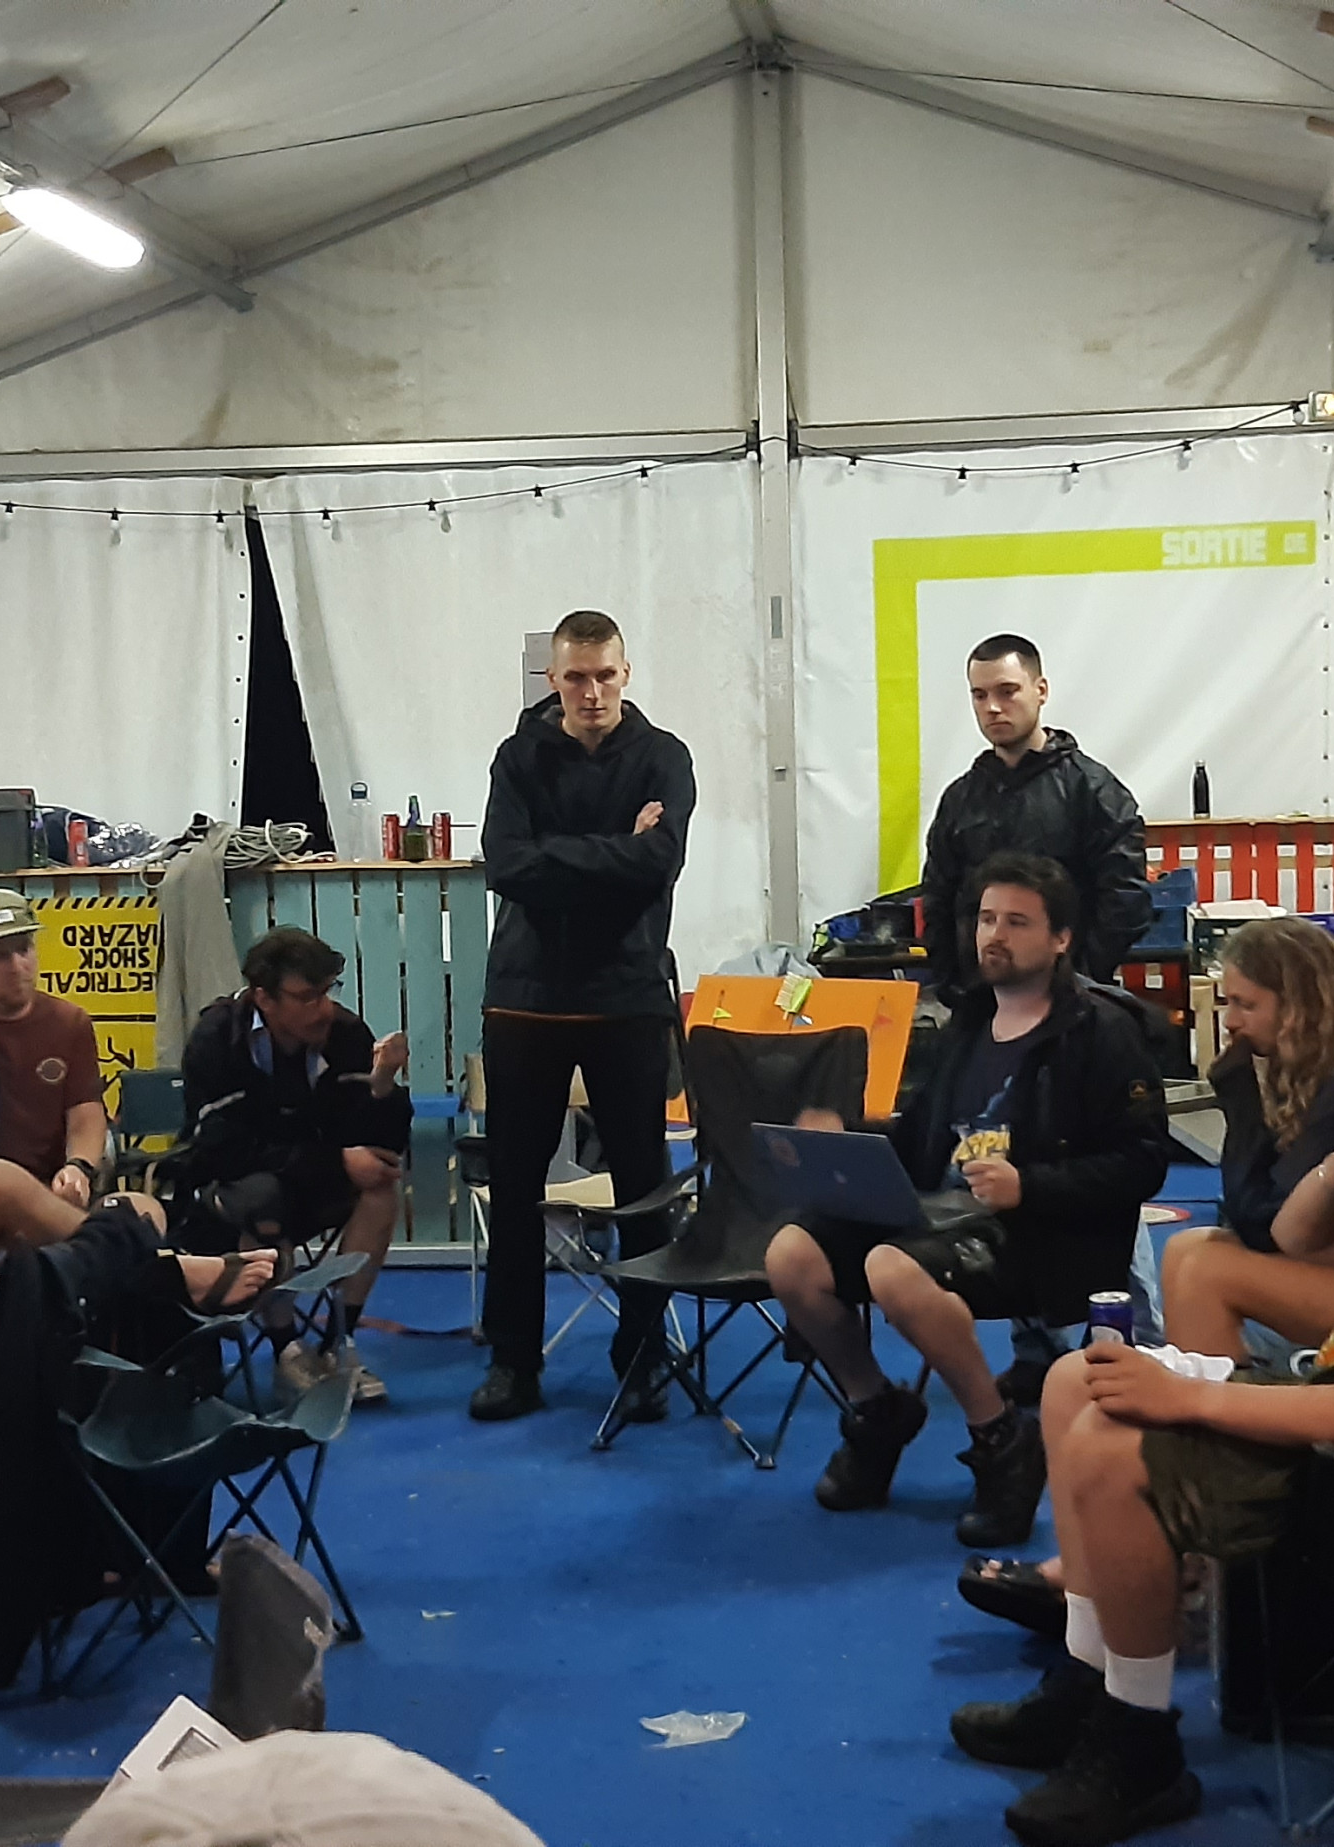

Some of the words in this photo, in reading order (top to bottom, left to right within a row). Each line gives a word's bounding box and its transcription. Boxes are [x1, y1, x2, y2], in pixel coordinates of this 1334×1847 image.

[1160, 526, 1268, 567] SORTIE
[62, 923, 157, 947] AZARD
[79, 947, 150, 969] SHOCK
[39, 971, 154, 994] ECTRICAL
